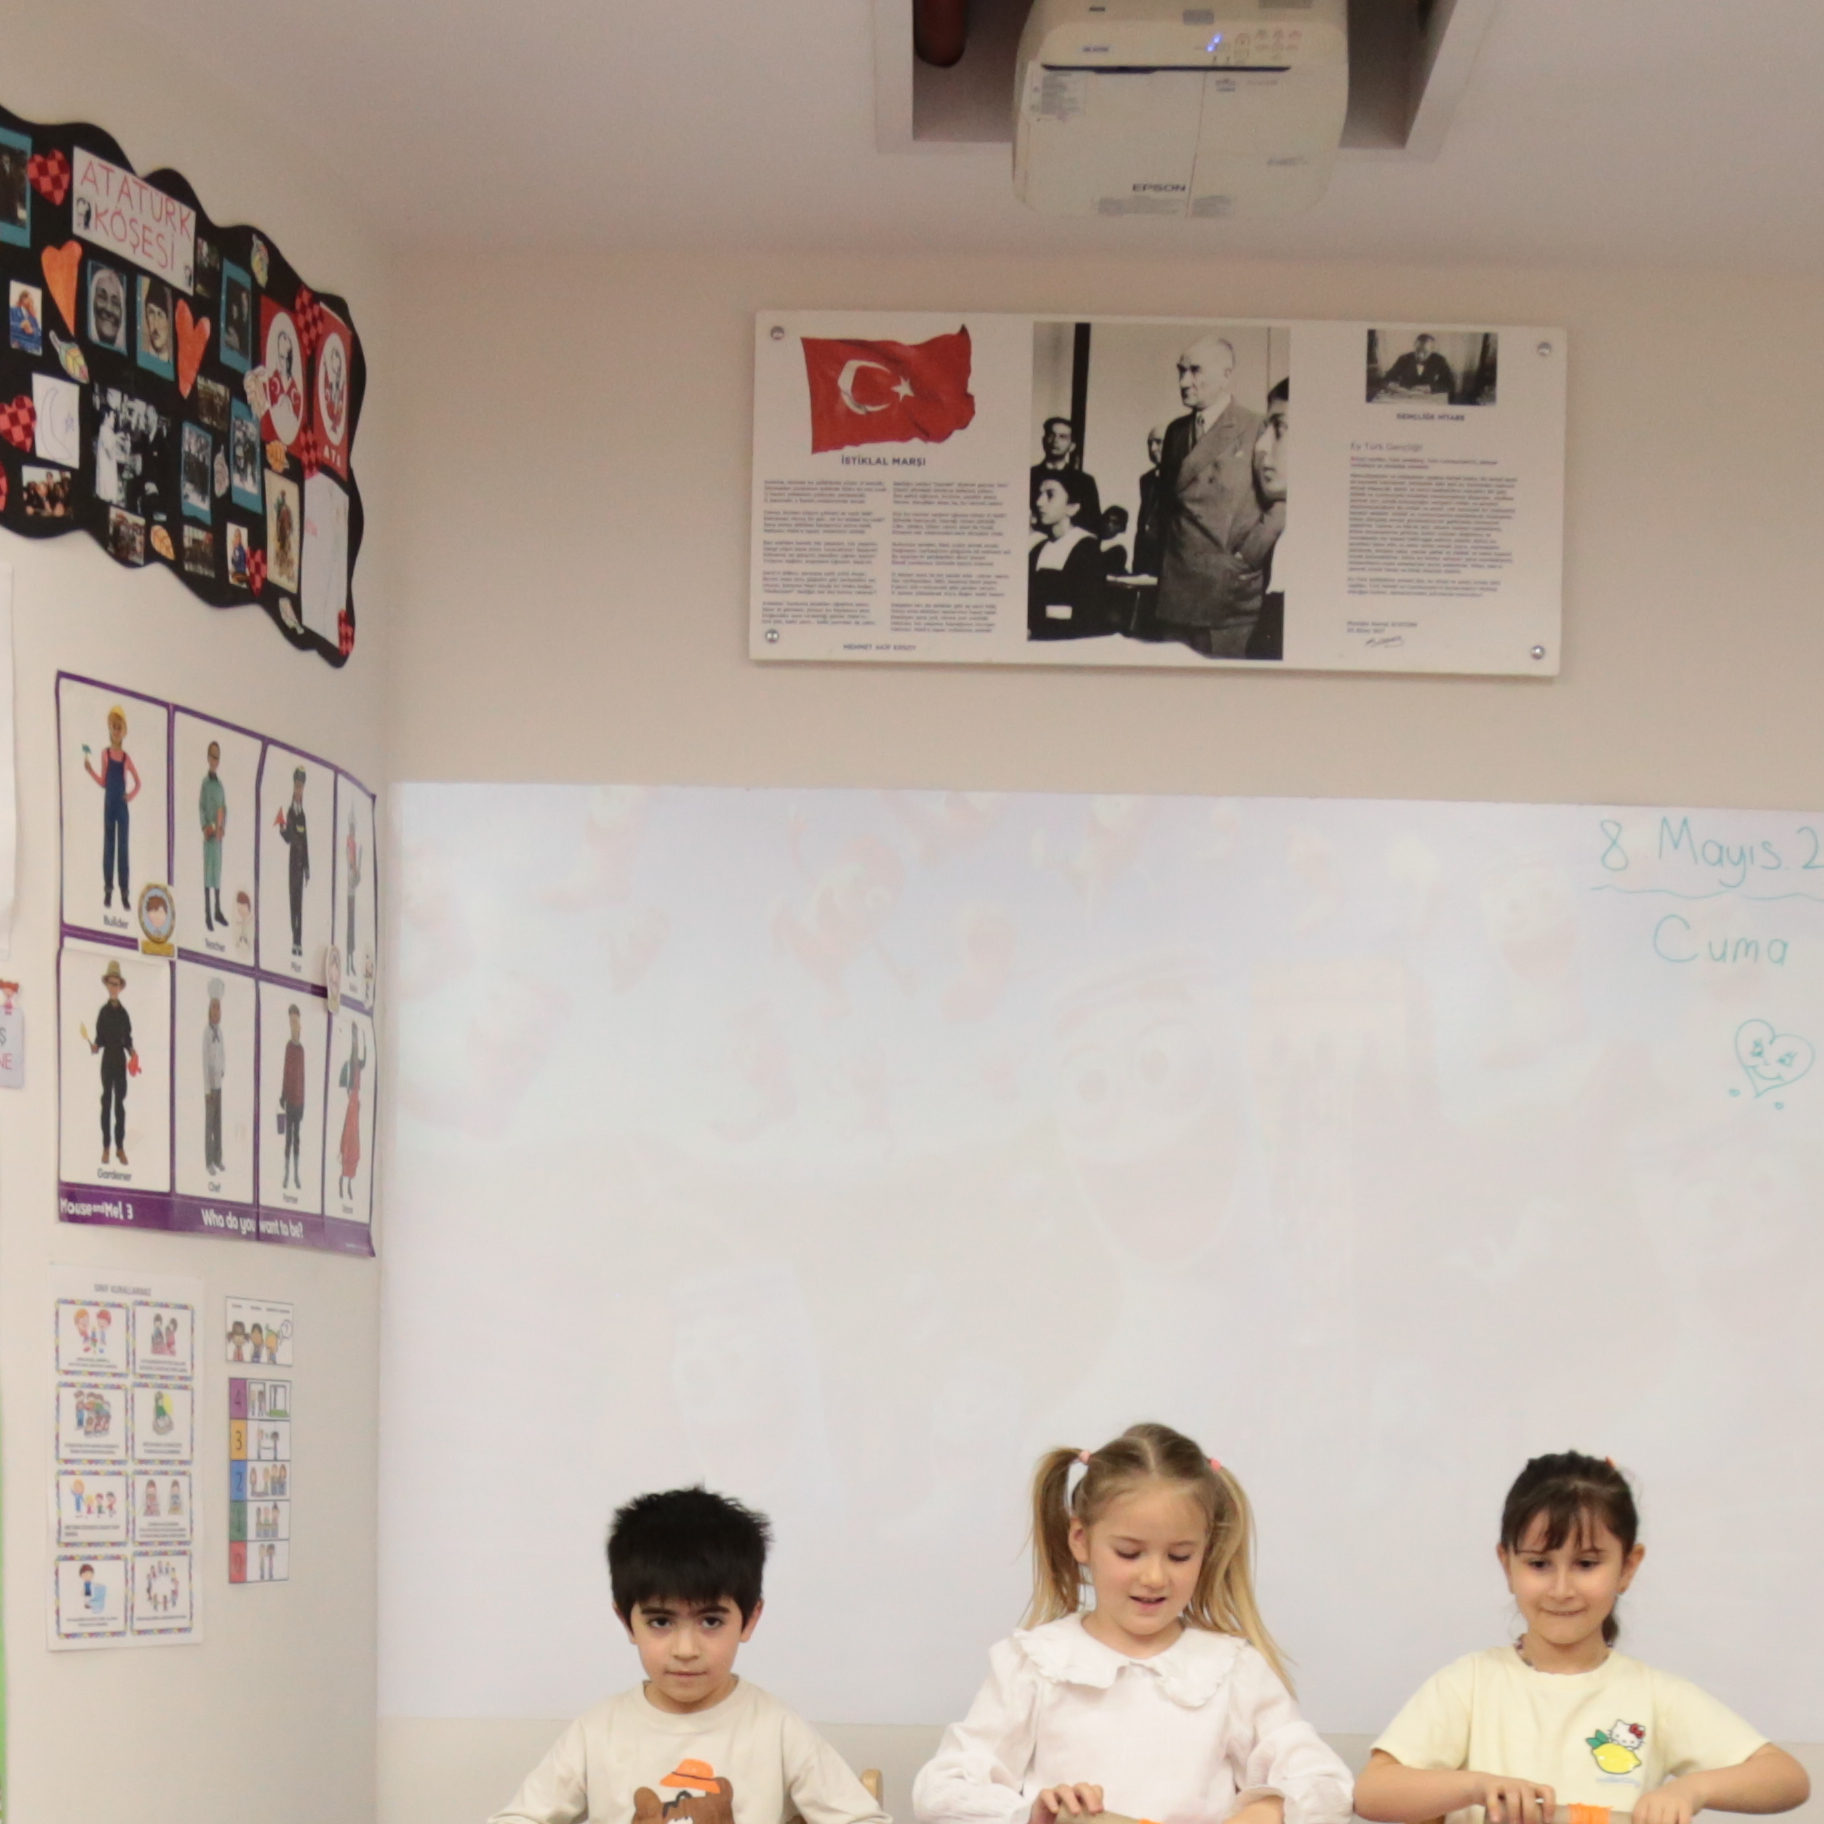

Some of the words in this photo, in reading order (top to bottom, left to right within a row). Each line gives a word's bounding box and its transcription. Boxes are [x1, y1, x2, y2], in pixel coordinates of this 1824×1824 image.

[1132, 183, 1186, 192] EPSON
[1600, 819, 1629, 872] 8
[103, 915, 129, 929] Builder
[1652, 914, 1790, 967] Cuma
[60, 1197, 92, 1216] Mouse
[201, 1208, 224, 1228] Who
[226, 1212, 238, 1230] do
[238, 1217, 257, 1235] you
[279, 1220, 288, 1236] to
[236, 1431, 242, 1450] 3
[236, 1473, 243, 1492] 2
